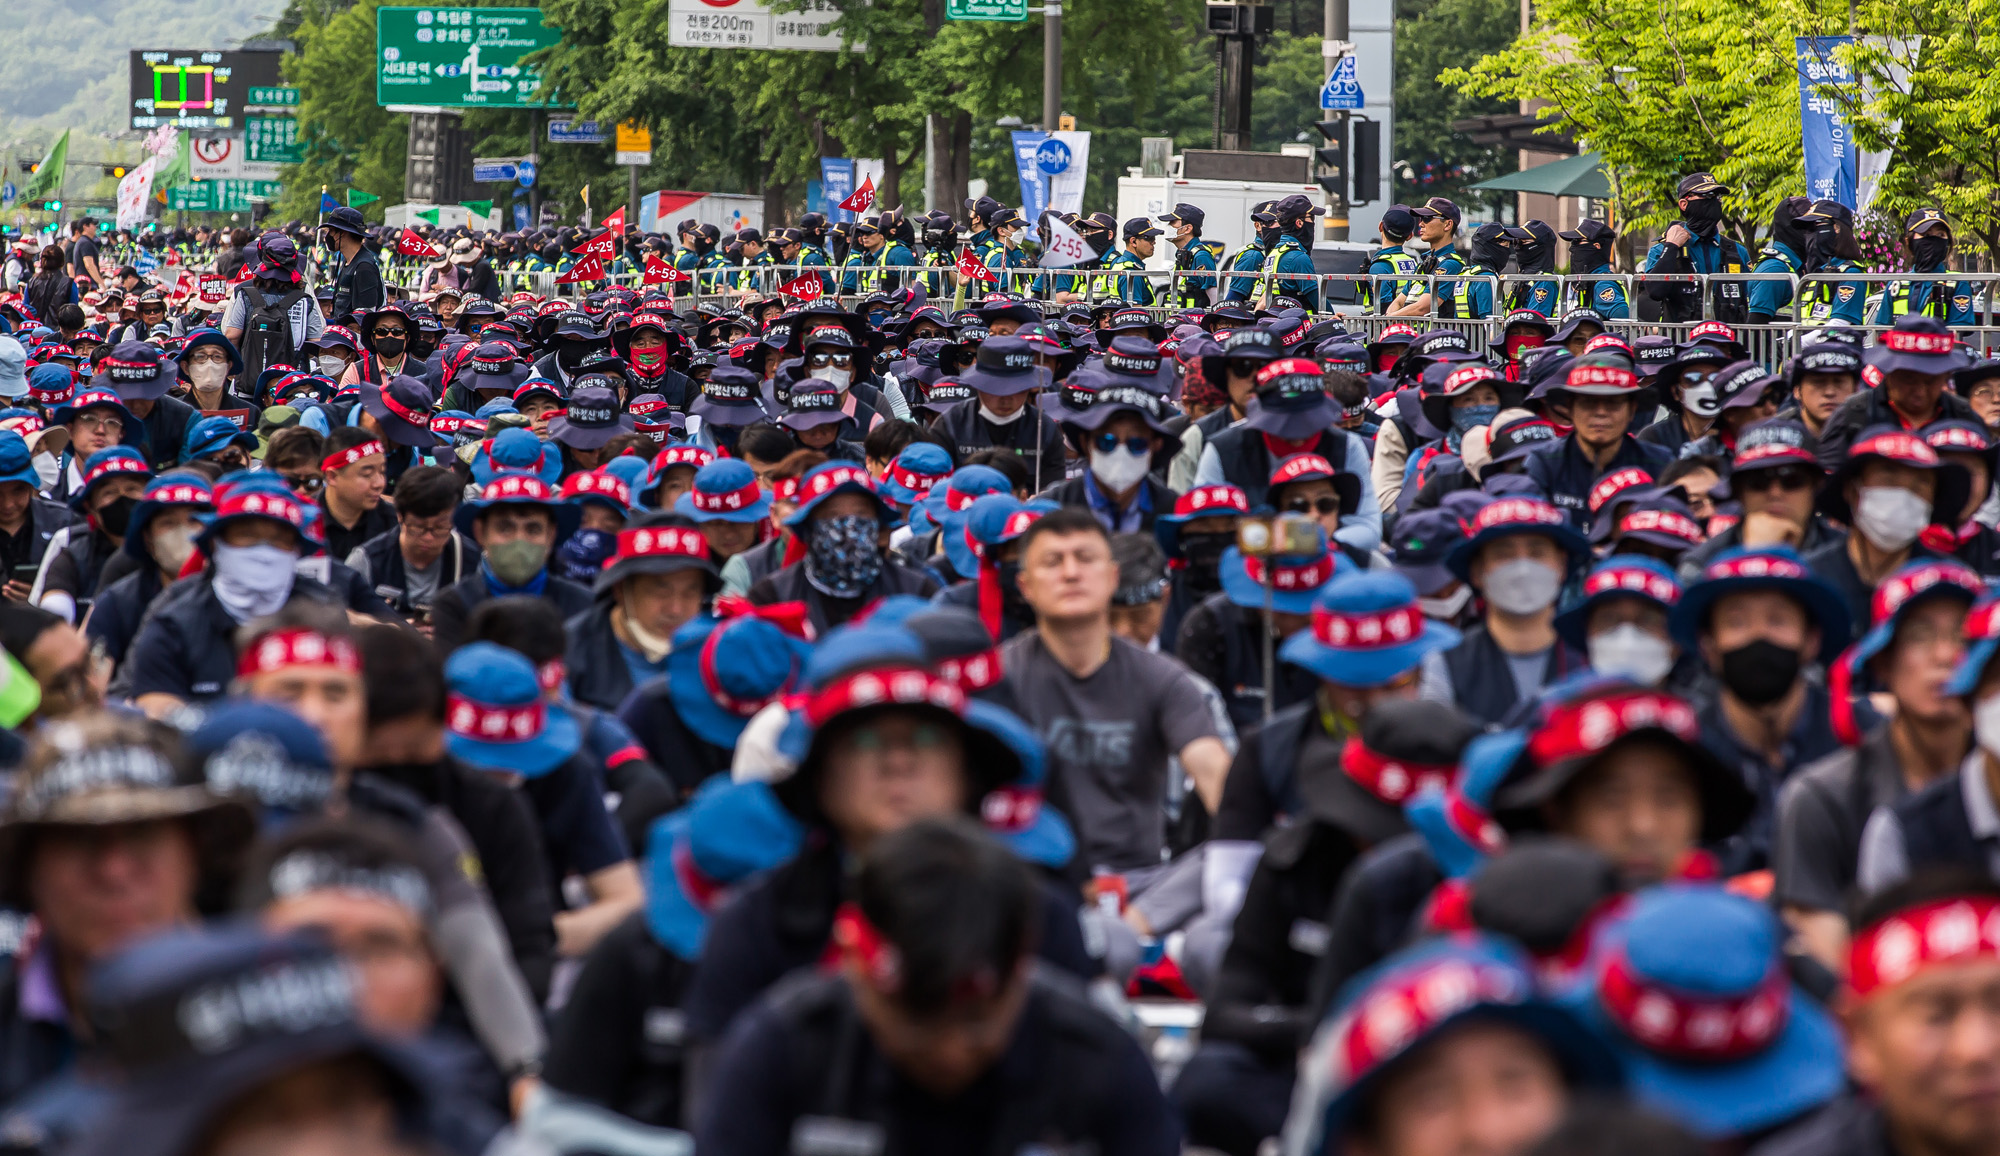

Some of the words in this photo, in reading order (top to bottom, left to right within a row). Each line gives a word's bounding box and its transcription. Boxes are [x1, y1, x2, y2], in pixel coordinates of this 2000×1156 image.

[436, 11, 472, 25] 독립문
[436, 28, 472, 43] 광화문
[382, 62, 431, 76] 서대문역
[850, 189, 875, 209] 4-15
[401, 236, 429, 254] 4-37
[587, 240, 613, 253] 4-29
[1052, 234, 1083, 259] 2-55
[570, 258, 600, 281] 4-11
[647, 265, 677, 280] 4-59
[957, 258, 987, 279] 4-18
[1111, 357, 1156, 369] 열사정신계승
[40, 389, 73, 402] 총파업
[792, 394, 834, 407] 열사정신계승
[568, 408, 611, 421] 열사정신계승
